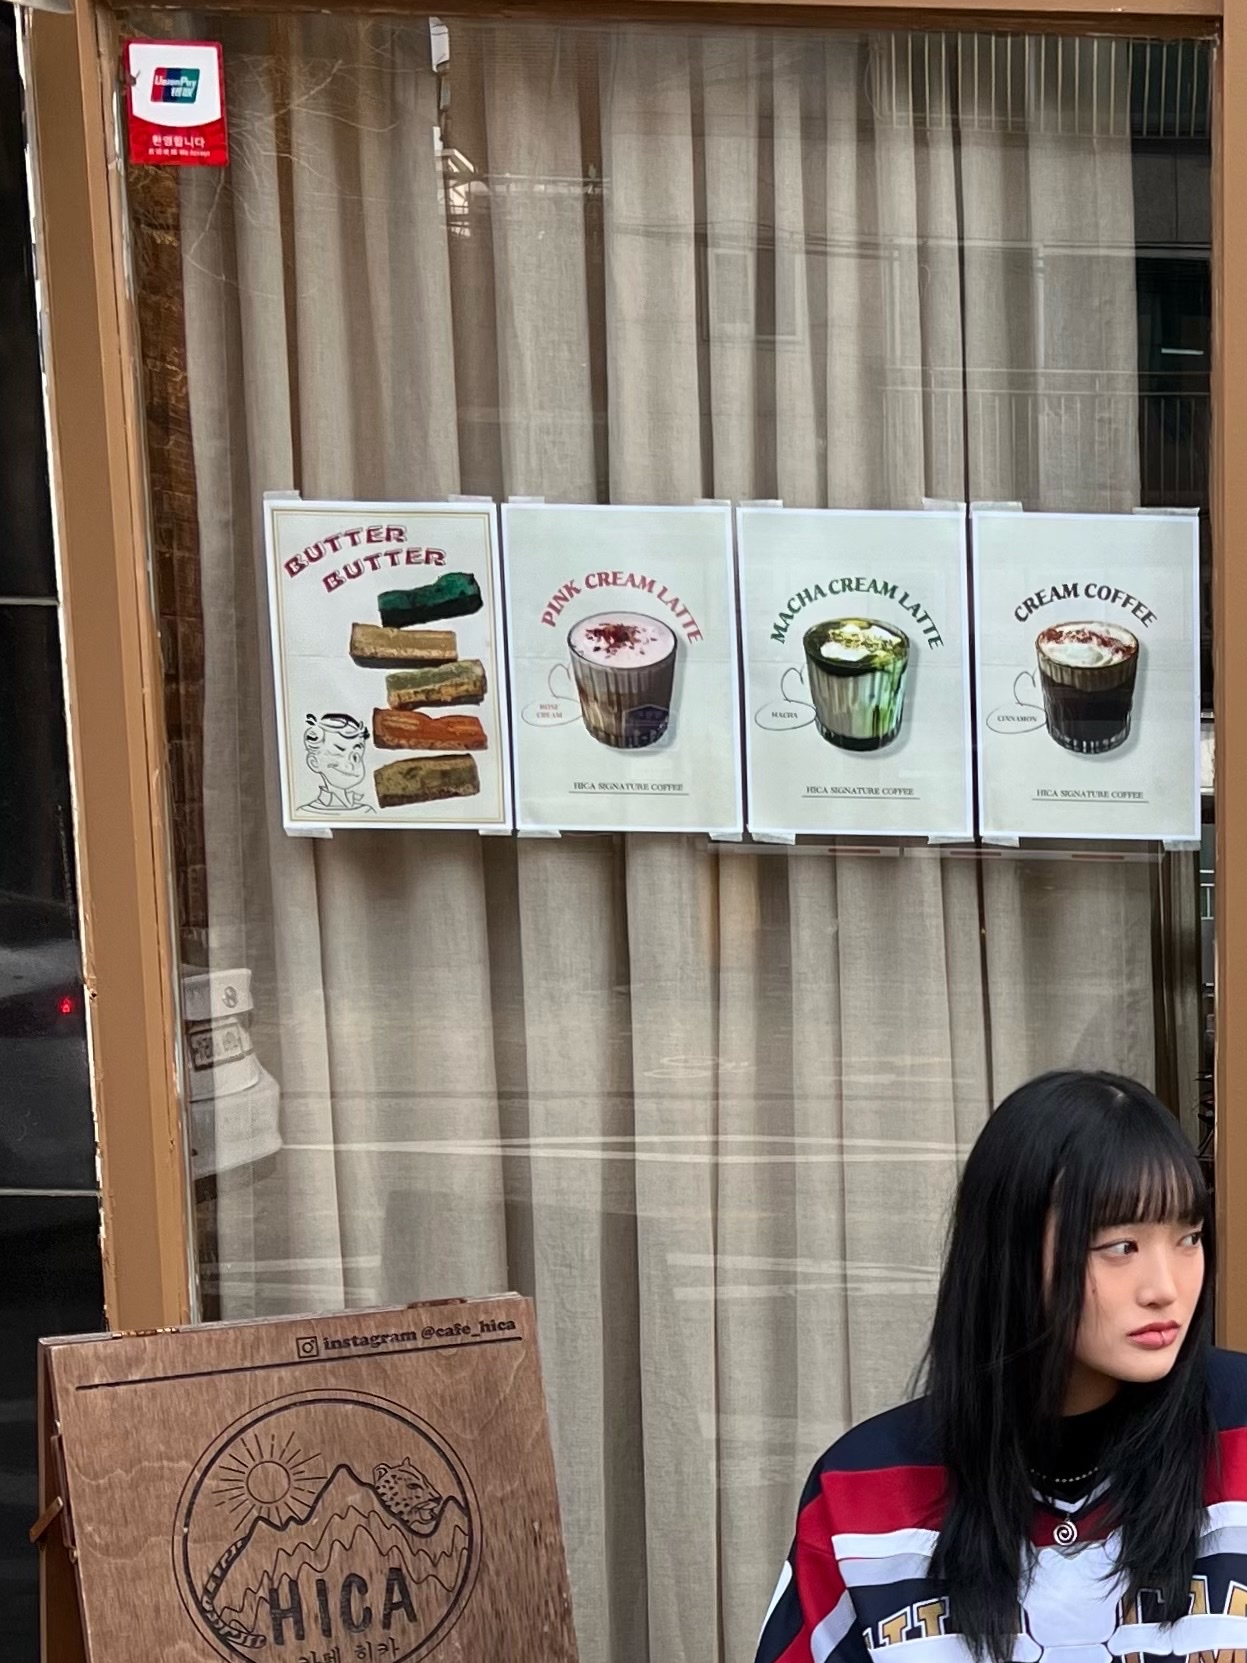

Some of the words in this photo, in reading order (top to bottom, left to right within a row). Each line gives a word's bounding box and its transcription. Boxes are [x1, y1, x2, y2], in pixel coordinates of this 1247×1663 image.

[283, 524, 408, 579] BUTTER
[321, 547, 447, 593] BUTTER
[541, 579, 582, 628] PINK
[584, 571, 657, 593] CREAM
[656, 585, 704, 645] LATTE
[770, 583, 827, 645] MACHA
[828, 577, 899, 599] CREAM
[898, 591, 945, 650] LATTE
[1014, 582, 1080, 623] CREAM
[1084, 582, 1158, 628] COFFEE
[573, 782, 596, 790] HICA
[598, 782, 649, 791] SIGNATURE
[651, 783, 683, 791] COFFEE
[806, 786, 828, 794] HICA
[830, 786, 880, 795] SIGNATURE
[881, 787, 914, 796] COFFEE
[1036, 789, 1058, 797] HICA
[1060, 789, 1109, 798] SIGNATURE
[1111, 790, 1144, 799] COFFEE
[323, 1330, 417, 1350] instagram
[420, 1319, 516, 1339] @cafe_hica
[269, 1567, 418, 1646] HICA
[355, 1637, 401, 1662] 히카
